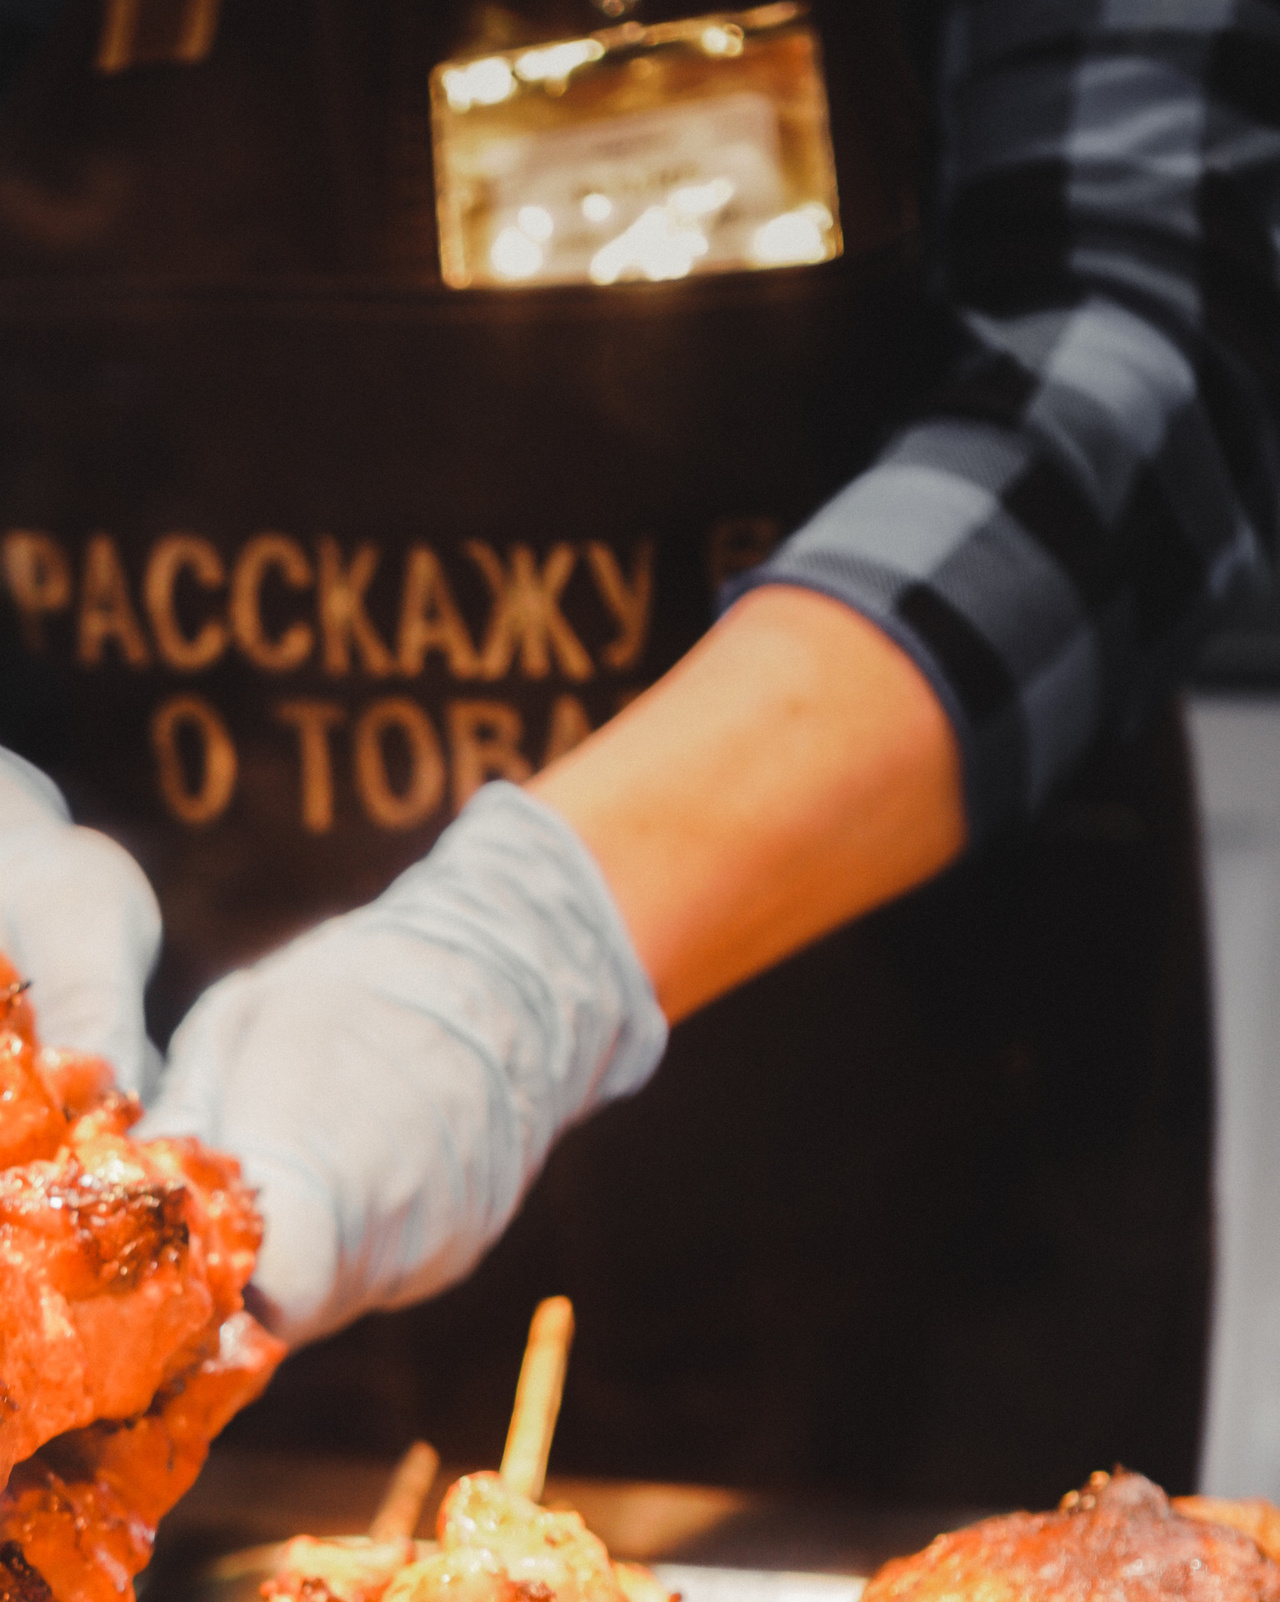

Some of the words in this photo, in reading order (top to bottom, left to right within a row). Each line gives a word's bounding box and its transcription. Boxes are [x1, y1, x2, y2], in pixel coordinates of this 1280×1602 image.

[4, 530, 654, 681] РАССКАЖУ
[151, 693, 237, 827] О
[277, 693, 642, 833] ТОВ
